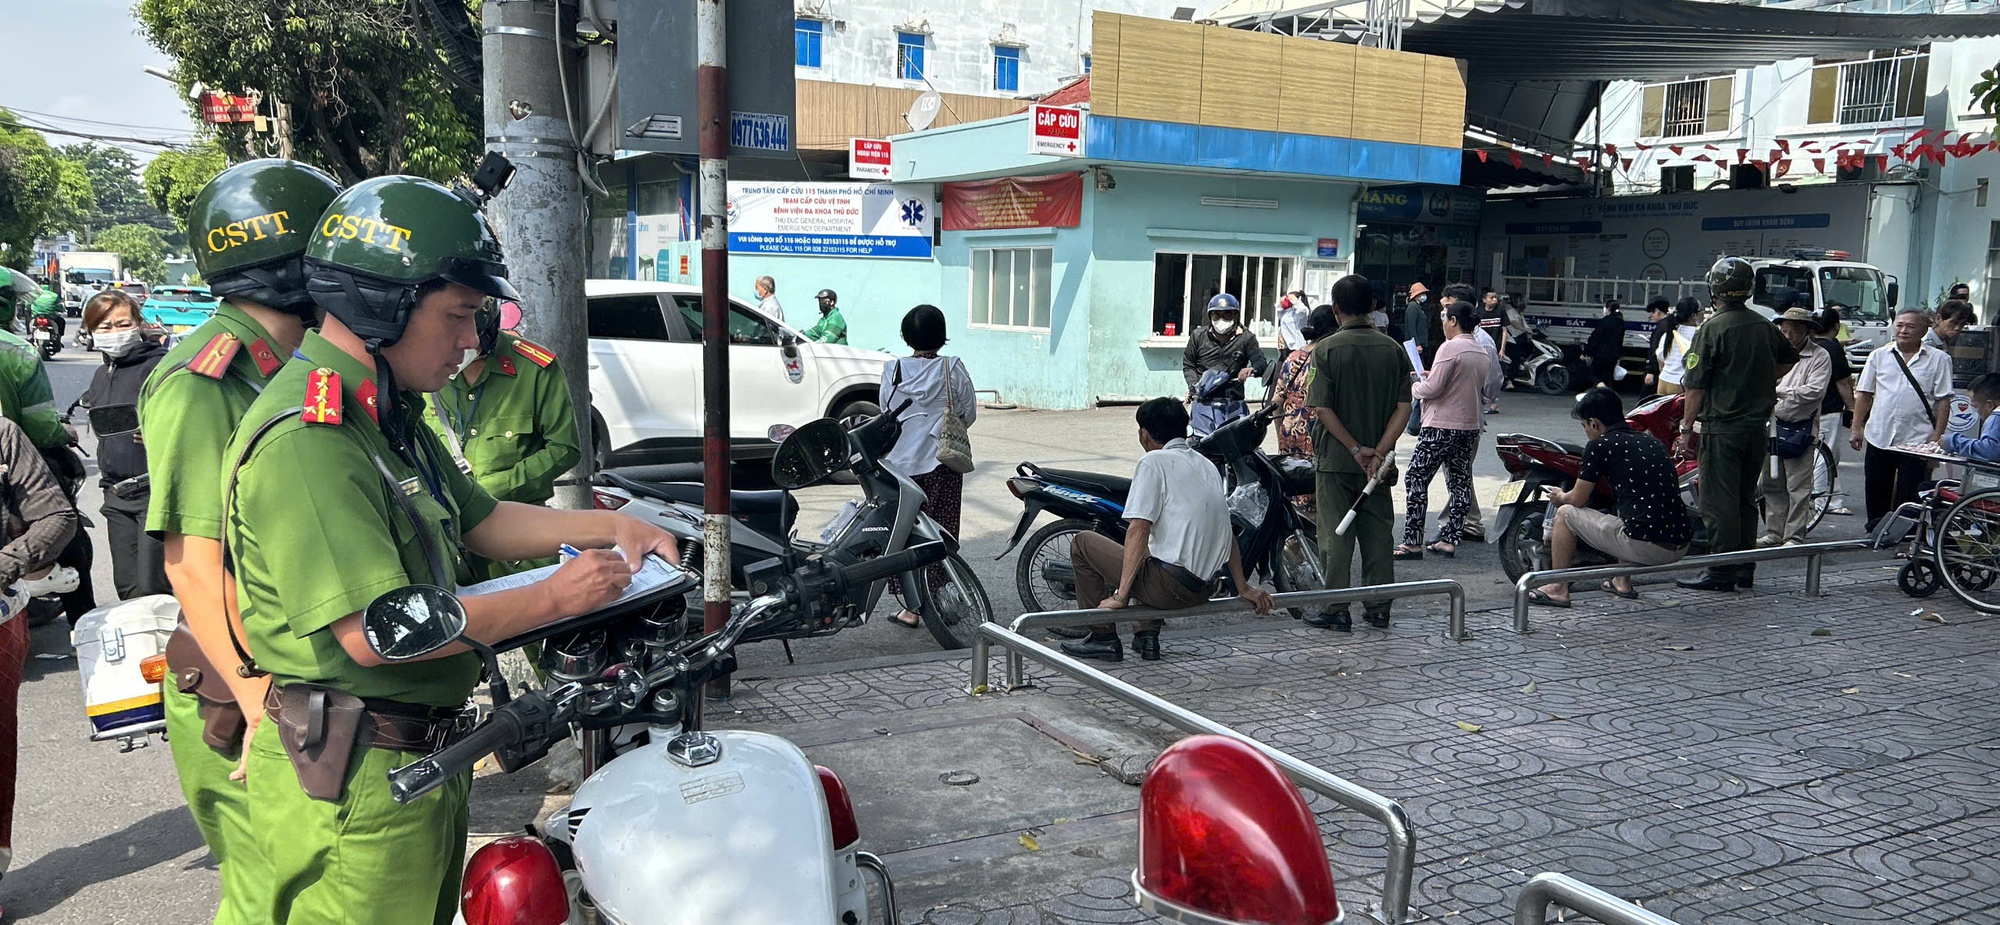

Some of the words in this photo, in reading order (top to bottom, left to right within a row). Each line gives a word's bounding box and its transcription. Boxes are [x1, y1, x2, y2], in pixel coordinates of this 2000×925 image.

[1038, 109, 1056, 126] CẤP
[1059, 112, 1077, 128] CỨU
[732, 119, 788, 150] 0977.636.444
[776, 186, 789, 194] CẤP
[839, 186, 852, 195] PHỐ
[864, 187, 876, 195] CHÍ
[800, 196, 812, 204] CẤP
[1647, 202, 1666, 211] KHOA
[207, 211, 290, 252] CSTT
[322, 214, 412, 251] CSTT
[1566, 318, 1586, 326] SÁT
